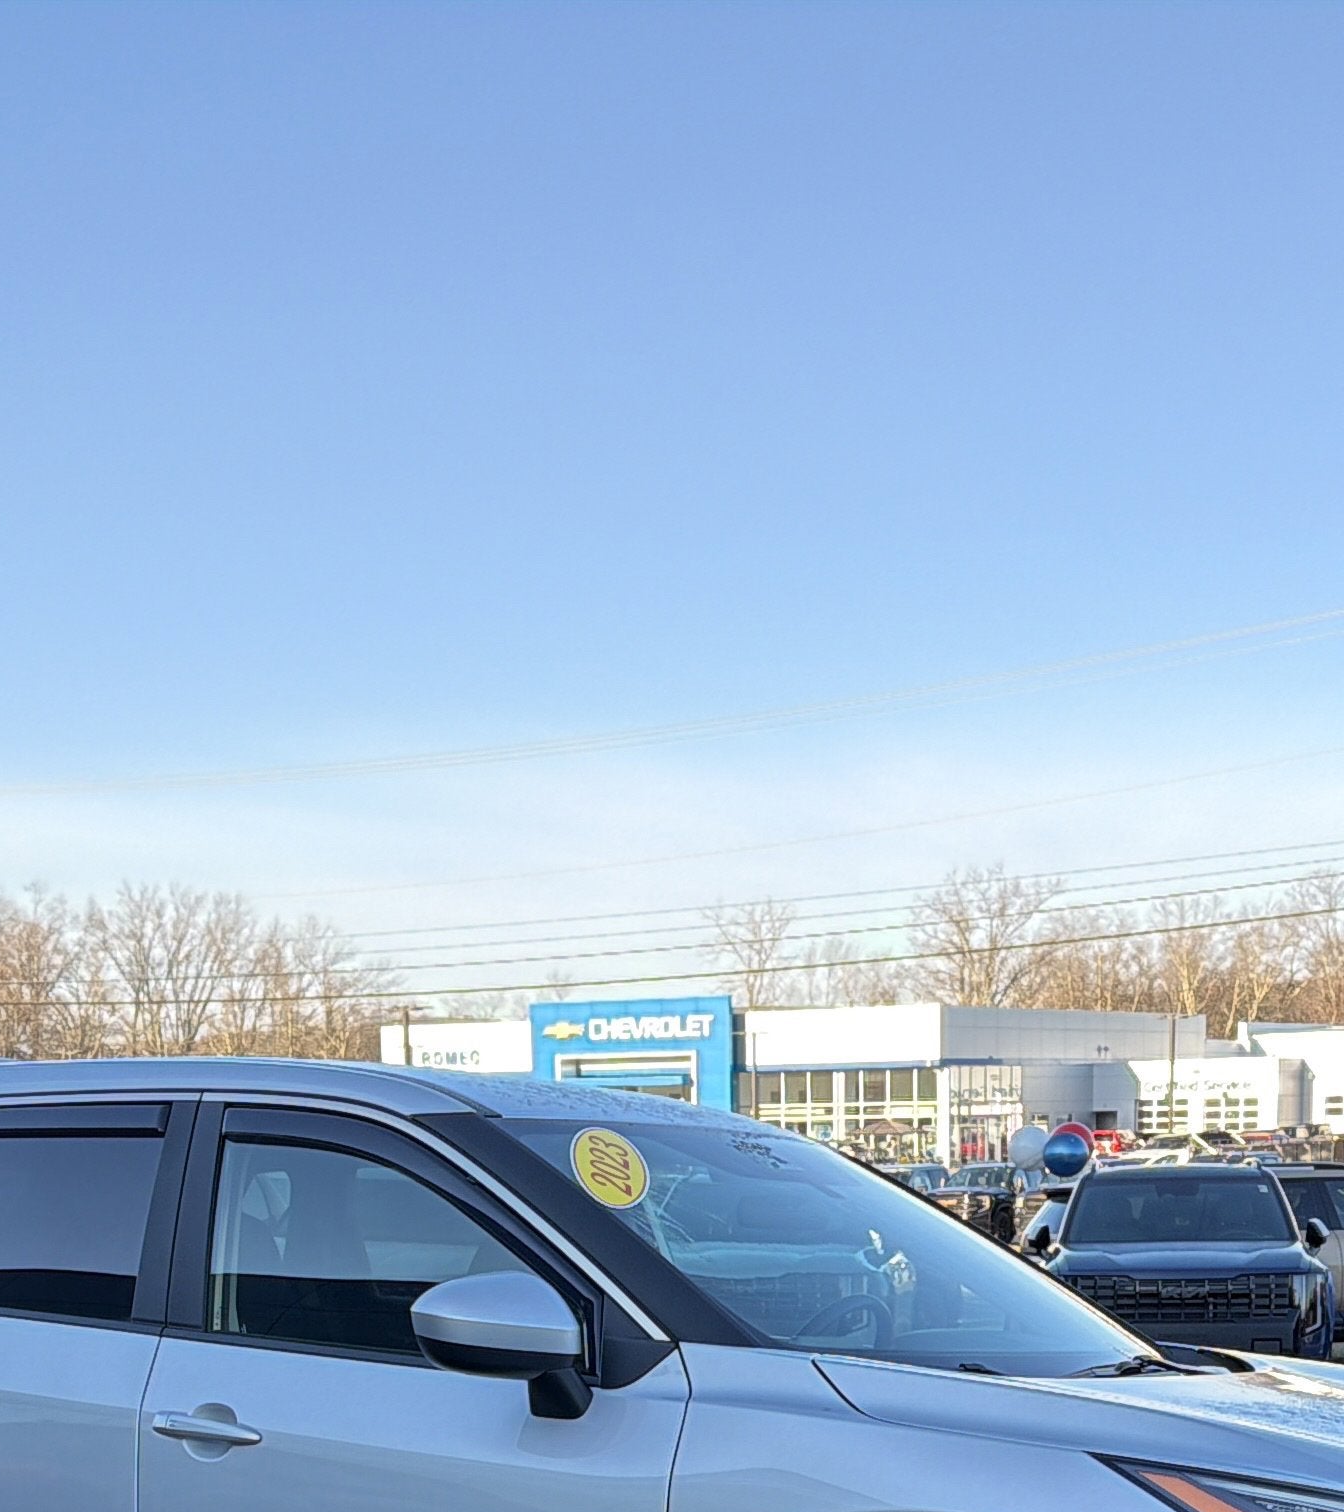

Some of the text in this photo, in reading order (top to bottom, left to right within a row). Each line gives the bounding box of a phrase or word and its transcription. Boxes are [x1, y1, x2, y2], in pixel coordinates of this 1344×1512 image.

[588, 1014, 715, 1041] CHEVROLET
[421, 1049, 480, 1066] ROMEO
[588, 1135, 633, 1197] 2023
